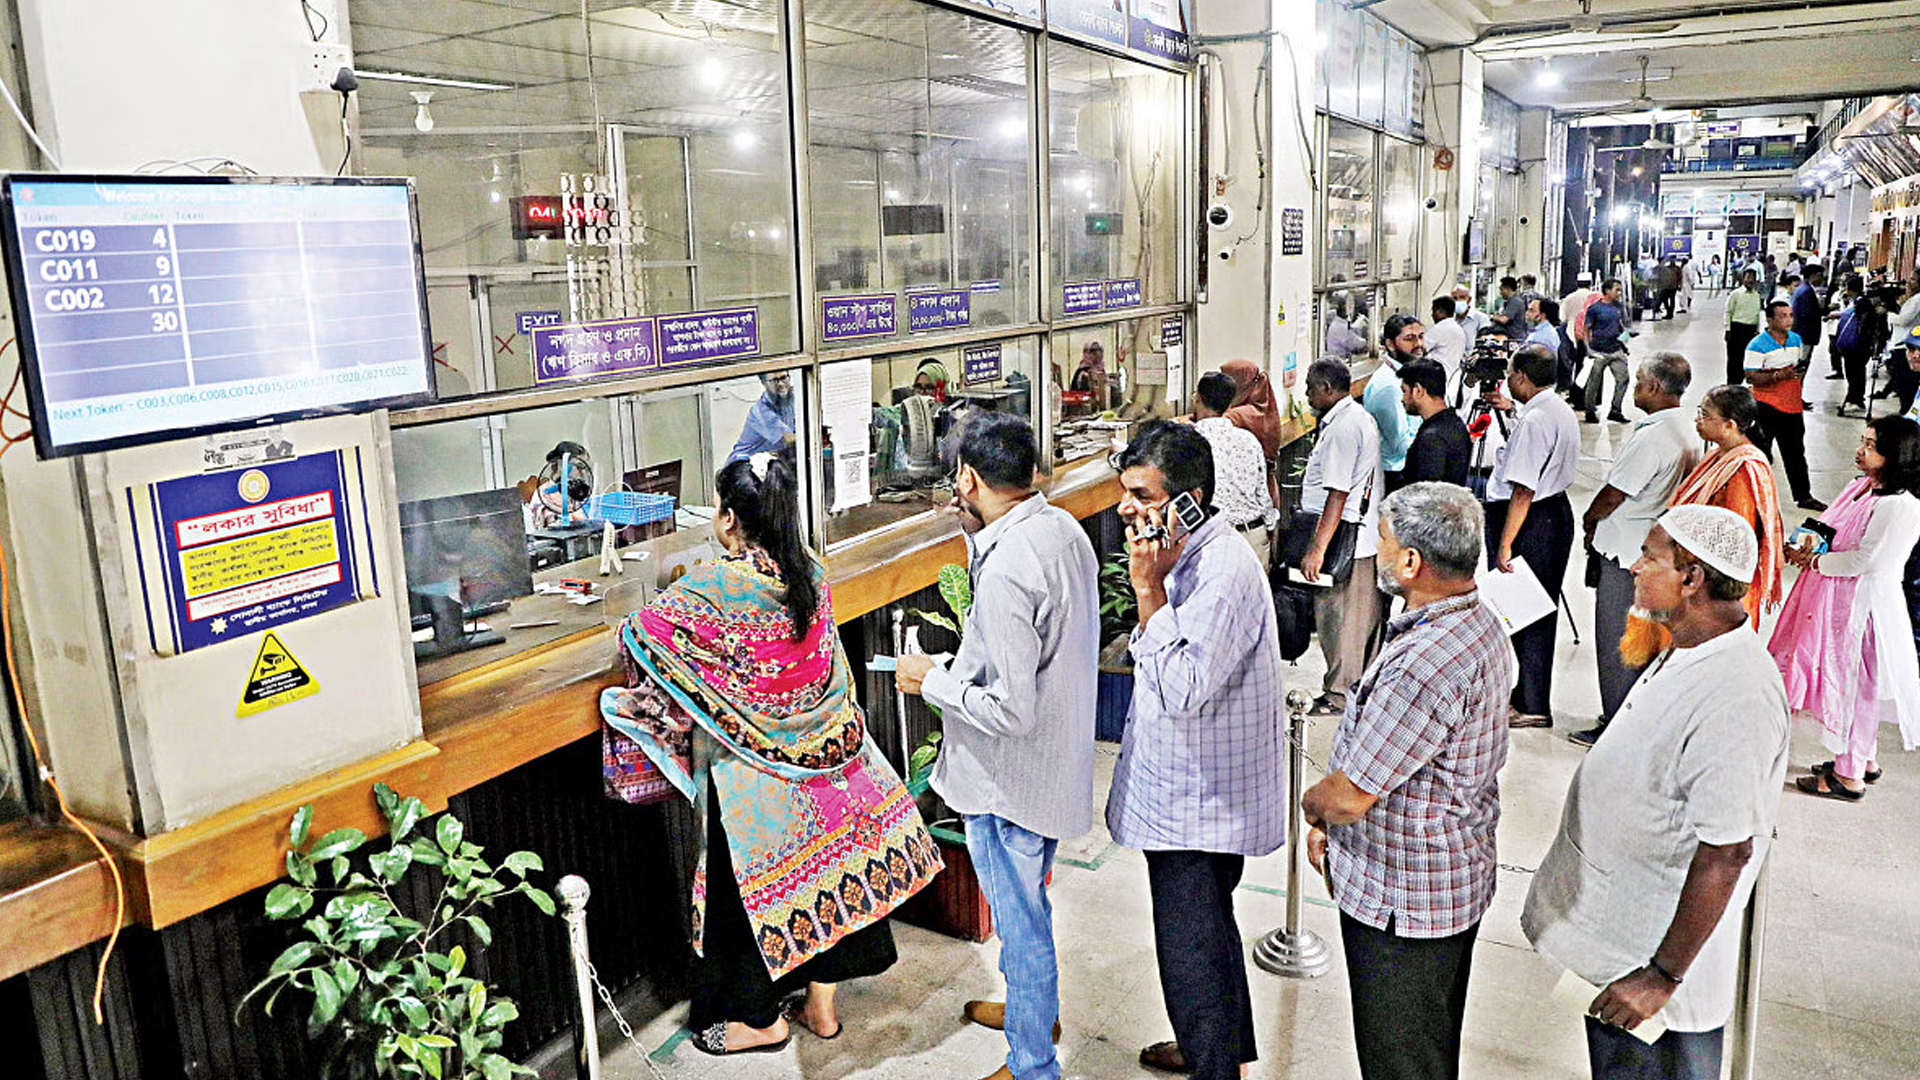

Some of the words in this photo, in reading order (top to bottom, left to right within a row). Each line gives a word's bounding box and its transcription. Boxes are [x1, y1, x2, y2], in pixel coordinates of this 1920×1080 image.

[35, 229, 96, 252] C019
[152, 227, 167, 248] 4
[40, 258, 99, 282] C011
[155, 255, 170, 276] 9
[45, 287, 105, 311] C002
[148, 283, 175, 304] 12
[151, 311, 178, 332] 30
[521, 314, 559, 331] EXIT
[604, 330, 613, 343] ও
[615, 326, 642, 342] প্রদান
[602, 351, 611, 363] ও
[53, 408, 83, 420] Next
